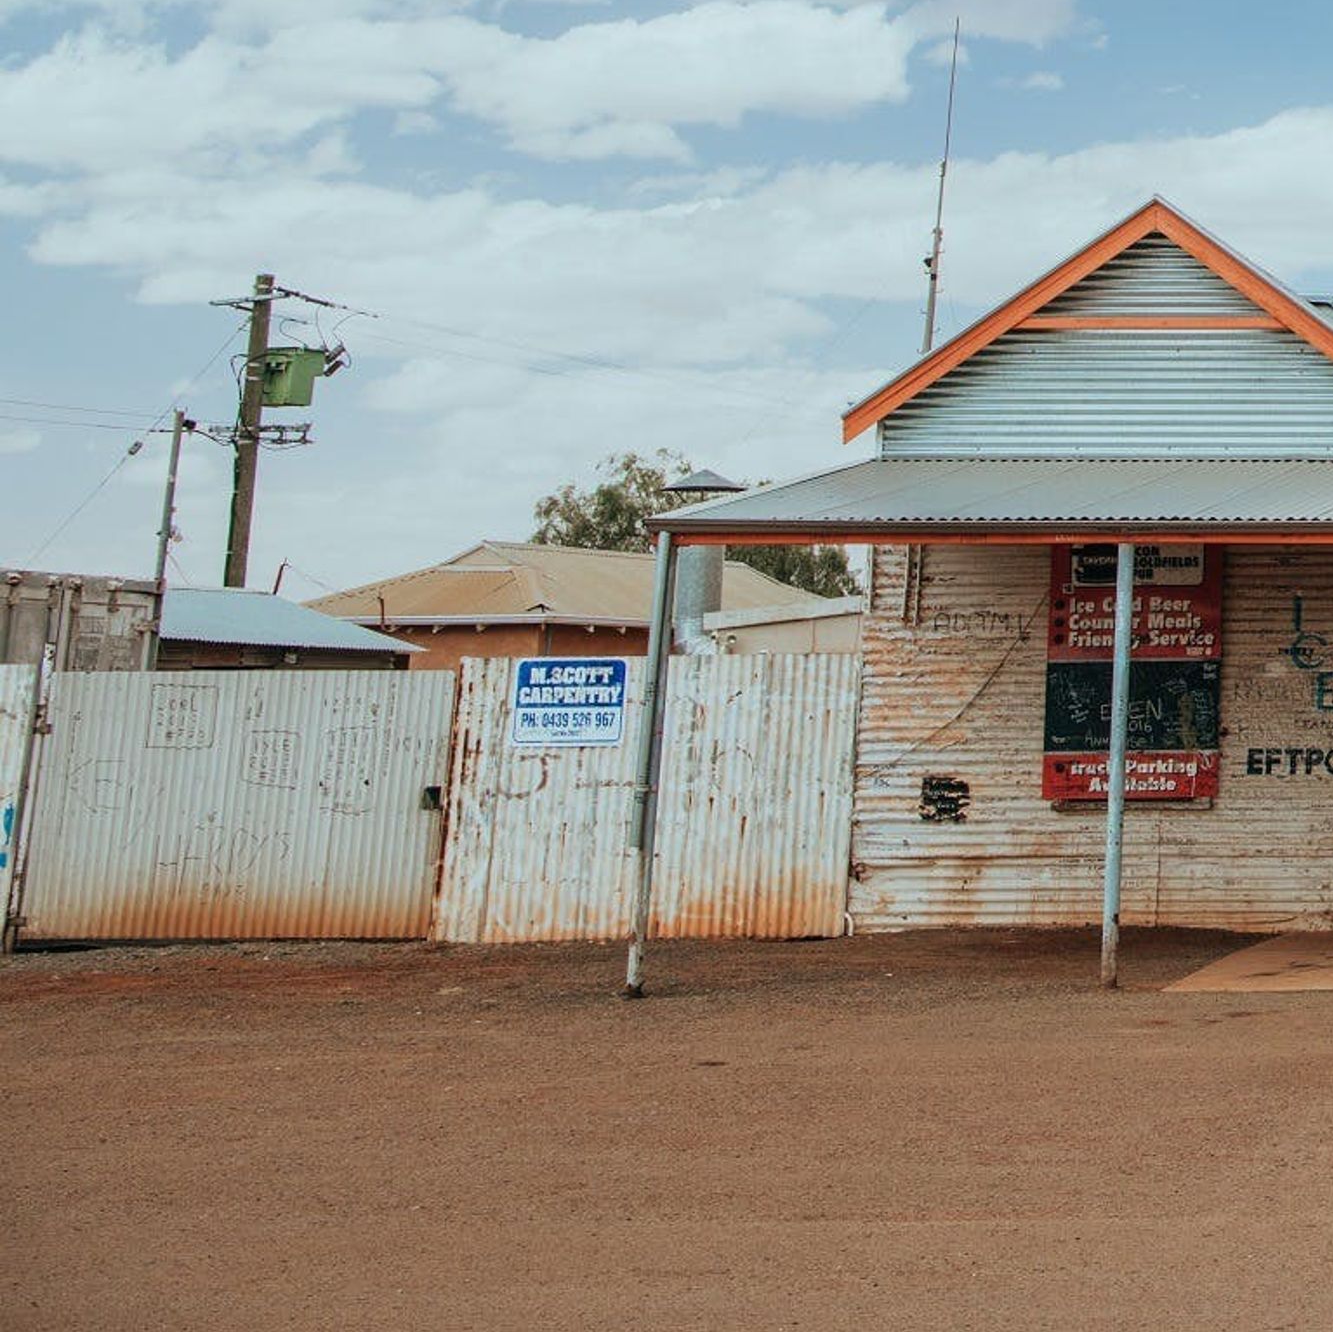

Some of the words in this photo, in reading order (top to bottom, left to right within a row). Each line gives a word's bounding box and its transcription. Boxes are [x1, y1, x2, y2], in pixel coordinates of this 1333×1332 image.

[1070, 598, 1095, 614] Ice
[1150, 597, 1190, 613] Beer
[1069, 614, 1145, 631] Counr
[1147, 613, 1201, 629] Meals
[1149, 631, 1214, 647] Service
[519, 682, 622, 704] CARPENTRY
[541, 712, 569, 727] 0439
[595, 712, 616, 727] 967
[1125, 758, 1198, 777] Parking
